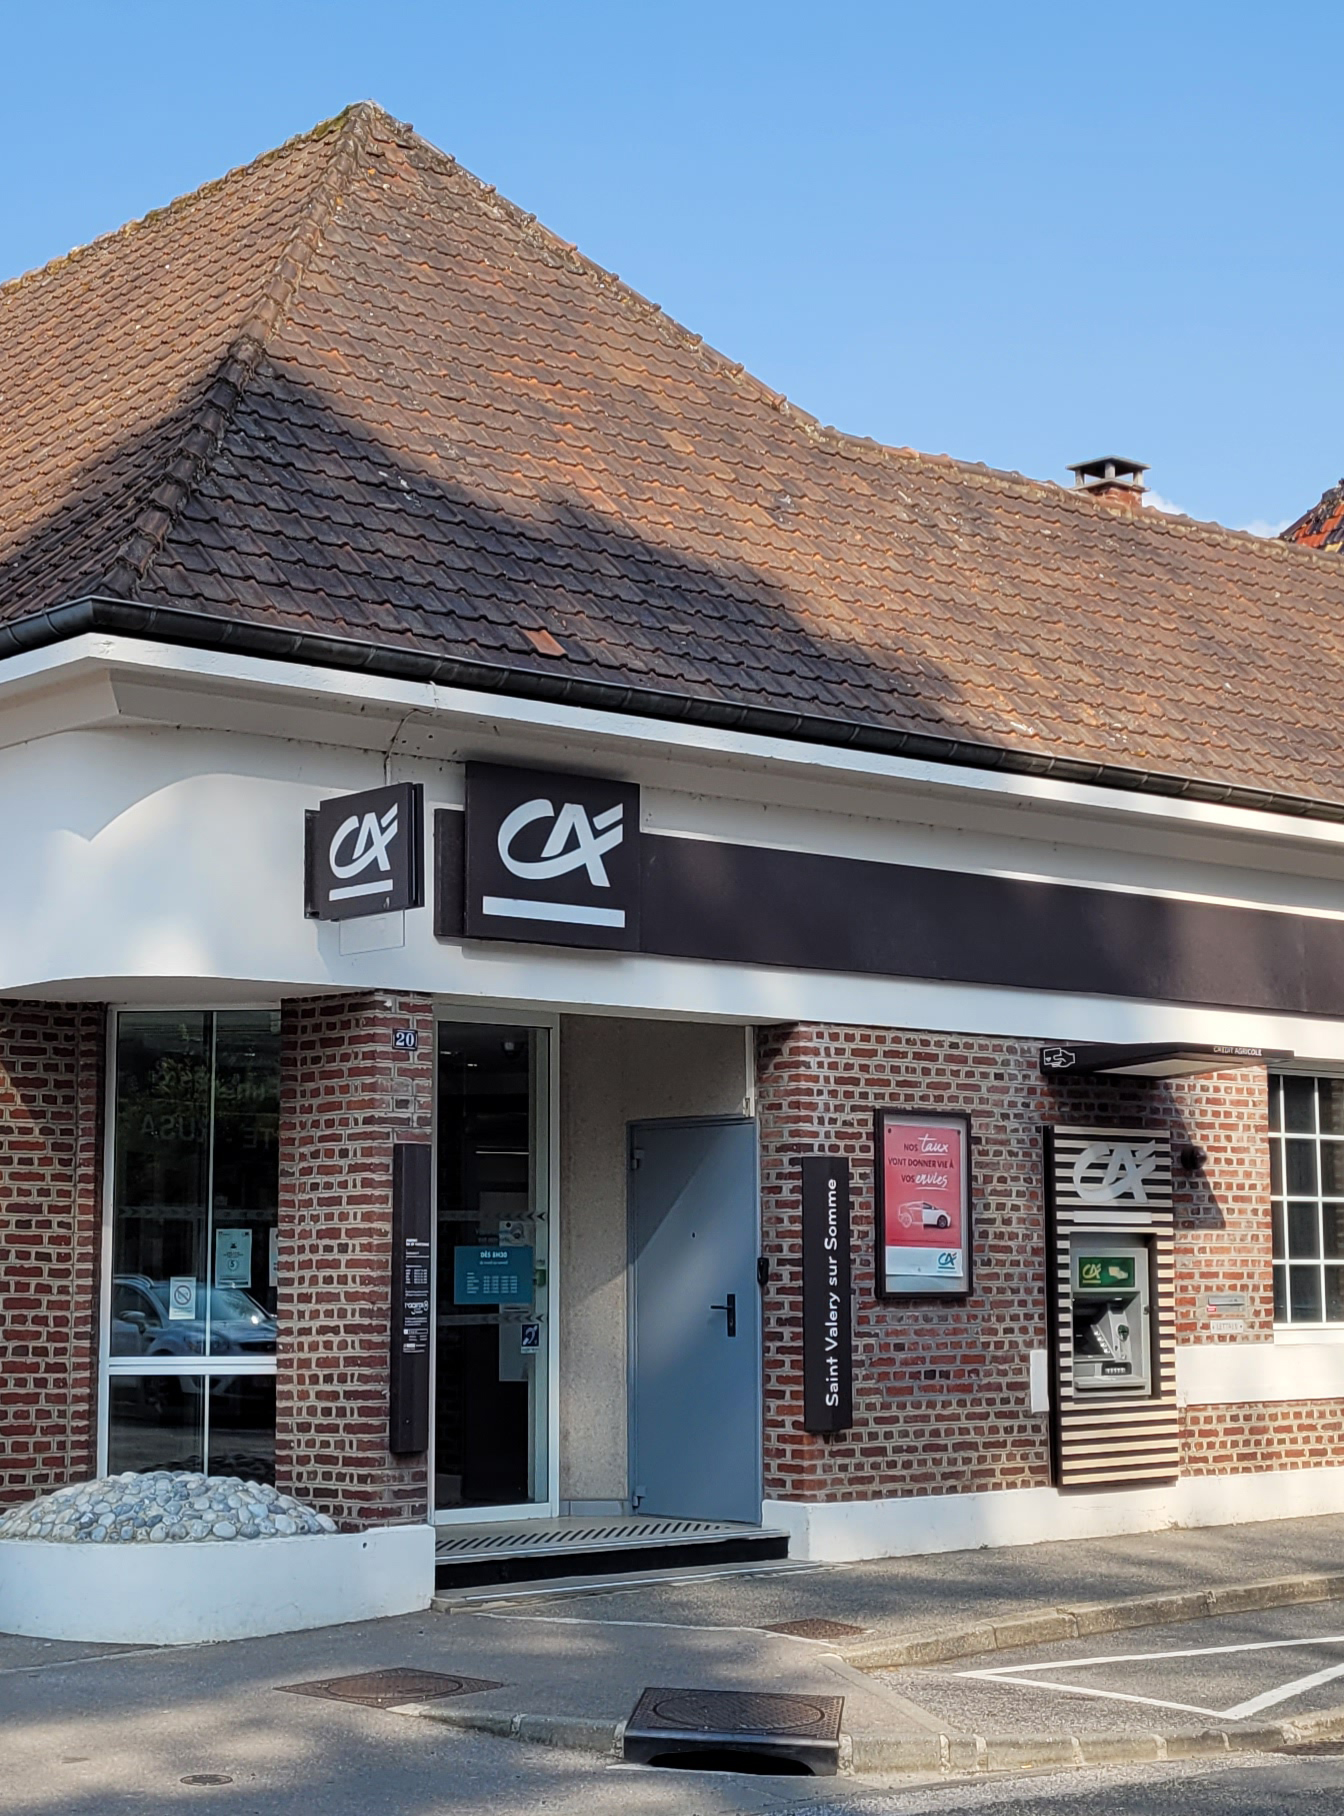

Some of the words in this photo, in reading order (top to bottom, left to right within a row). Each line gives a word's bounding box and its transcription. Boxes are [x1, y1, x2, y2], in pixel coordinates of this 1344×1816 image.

[396, 1032, 414, 1047] 20
[904, 1143, 918, 1152] NOS
[918, 1134, 949, 1153] taux
[888, 1157, 907, 1167] VONT
[908, 1158, 936, 1168] DONNER
[937, 1160, 948, 1169] VIE
[901, 1174, 915, 1183] VOS
[915, 1171, 948, 1188] envies
[824, 1179, 838, 1250] Somme
[828, 1256, 838, 1286] sur
[825, 1292, 840, 1351] Valery
[826, 1357, 839, 1407] Saint
